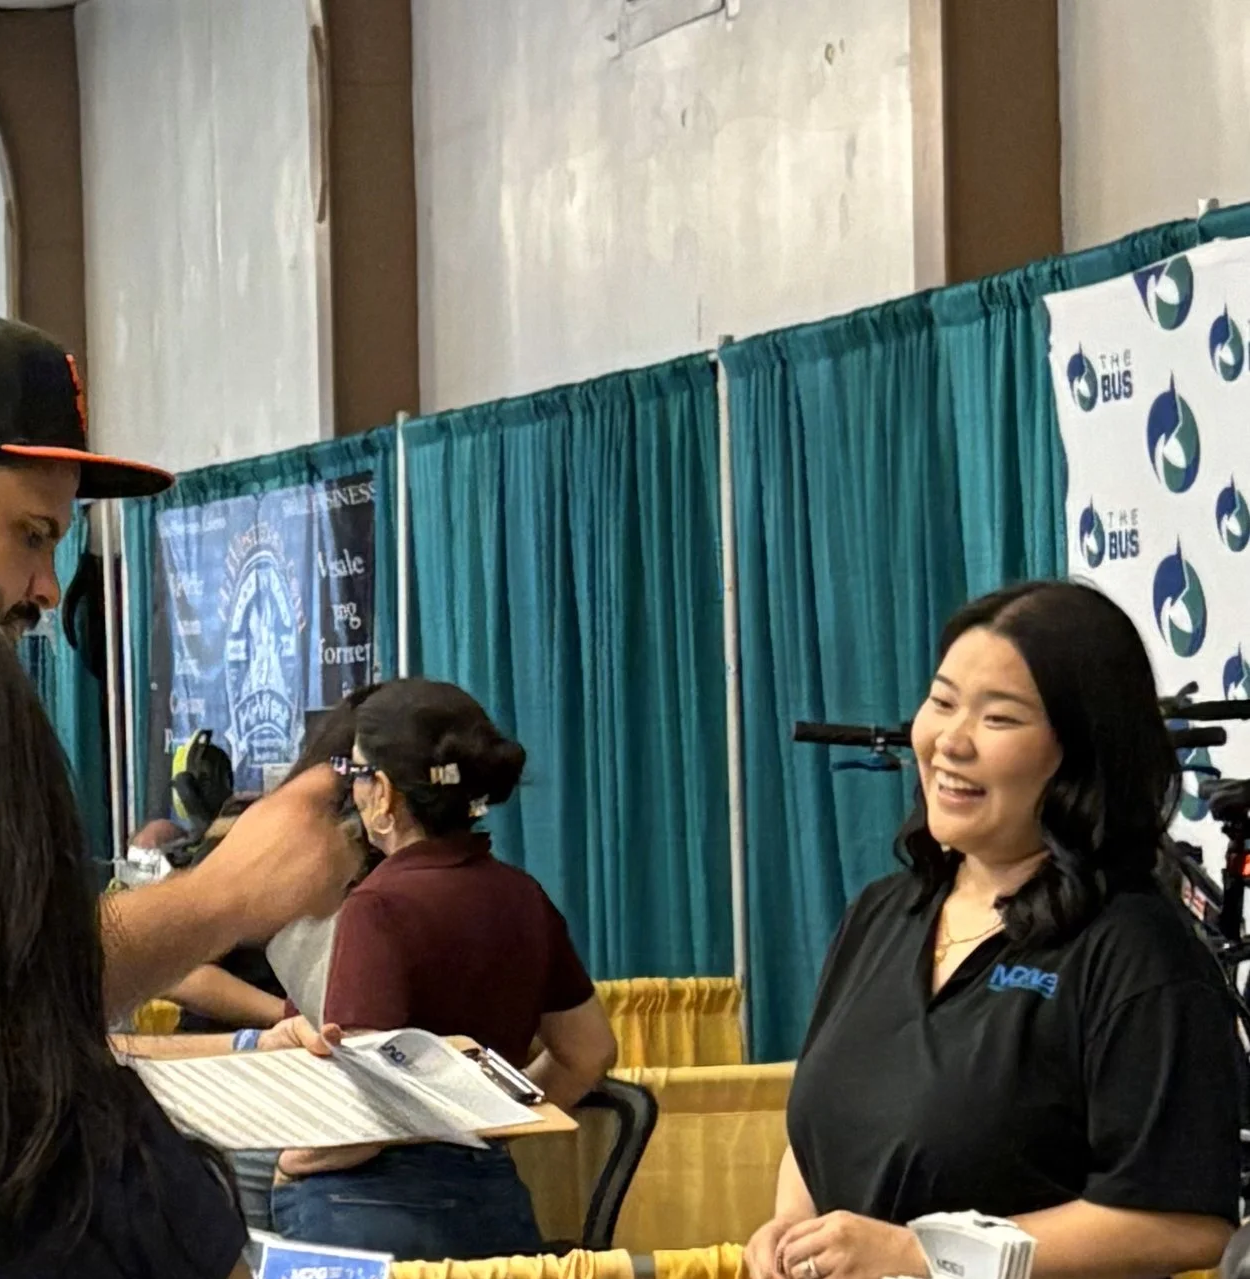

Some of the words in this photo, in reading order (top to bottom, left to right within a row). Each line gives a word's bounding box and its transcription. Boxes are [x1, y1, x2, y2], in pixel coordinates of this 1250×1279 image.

[1099, 349, 1132, 370] THE
[1101, 370, 1133, 403] BUS
[1107, 508, 1139, 529] THE
[1108, 529, 1140, 560] BUS
